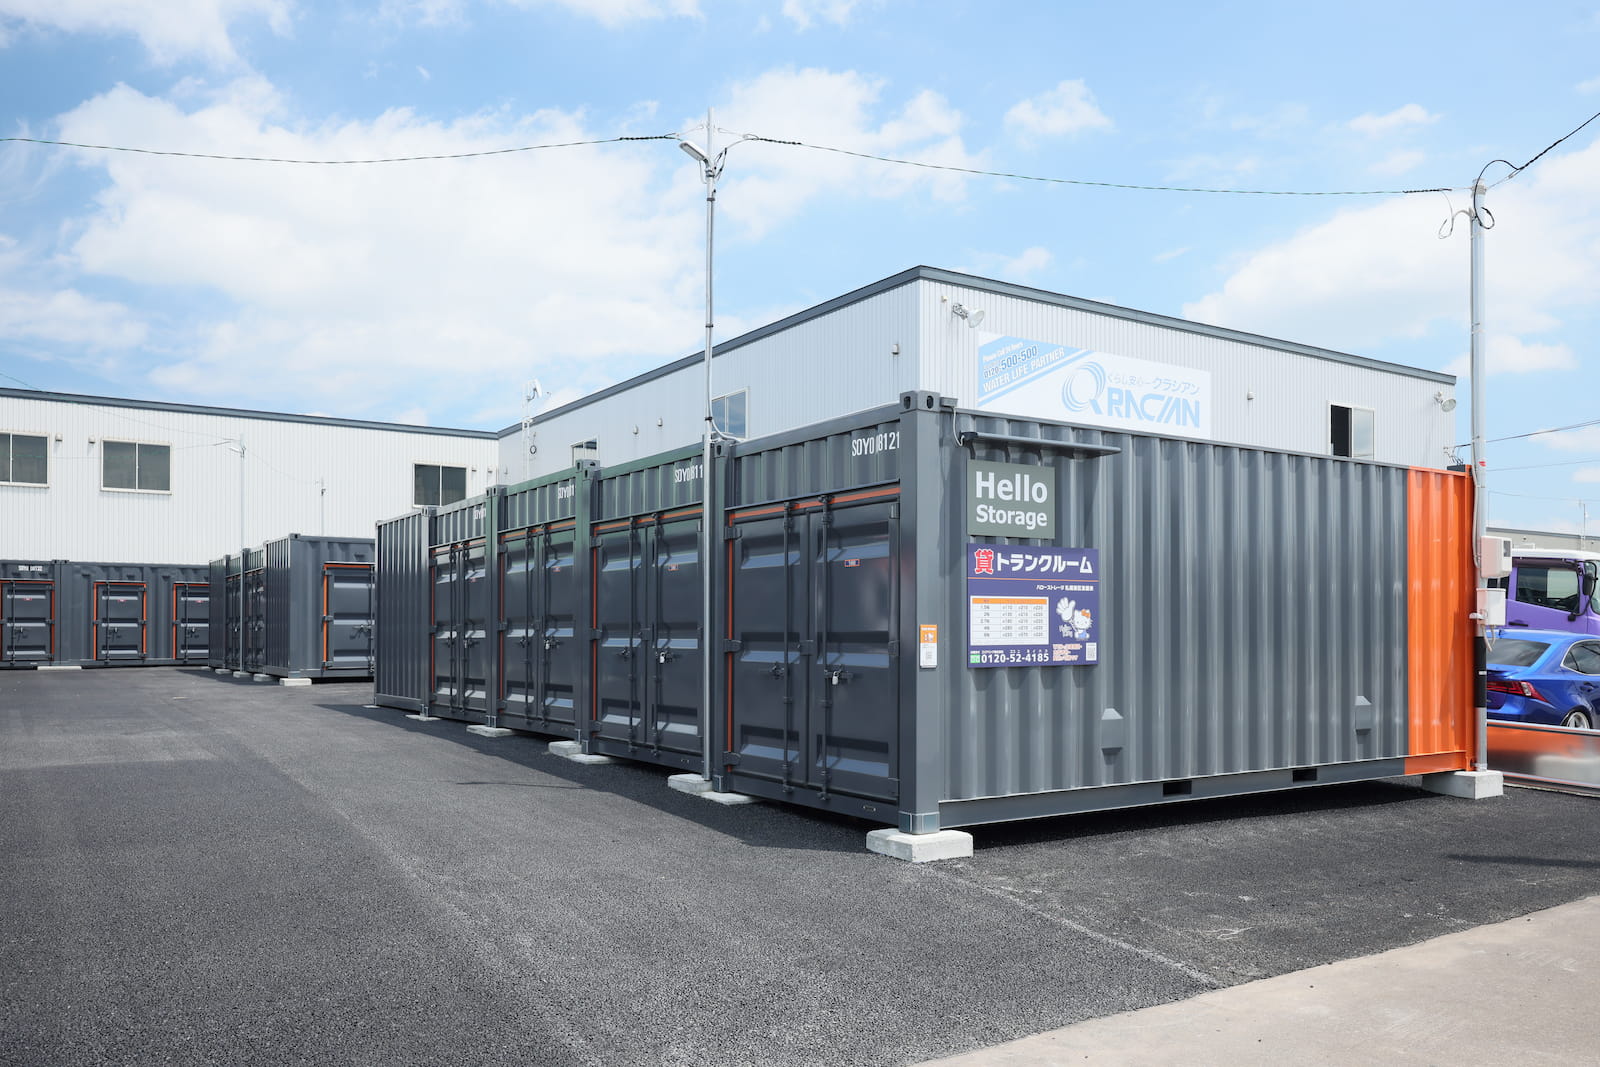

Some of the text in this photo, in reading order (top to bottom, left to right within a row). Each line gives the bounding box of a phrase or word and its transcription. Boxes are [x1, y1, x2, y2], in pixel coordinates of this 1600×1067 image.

[983, 372, 1011, 392] WATER
[1011, 364, 1030, 380] LIFE
[1030, 347, 1065, 371] PARTNER
[975, 470, 1048, 504] Hello
[976, 504, 1048, 530] Storage
[981, 653, 1050, 664] 0120-52-4185
